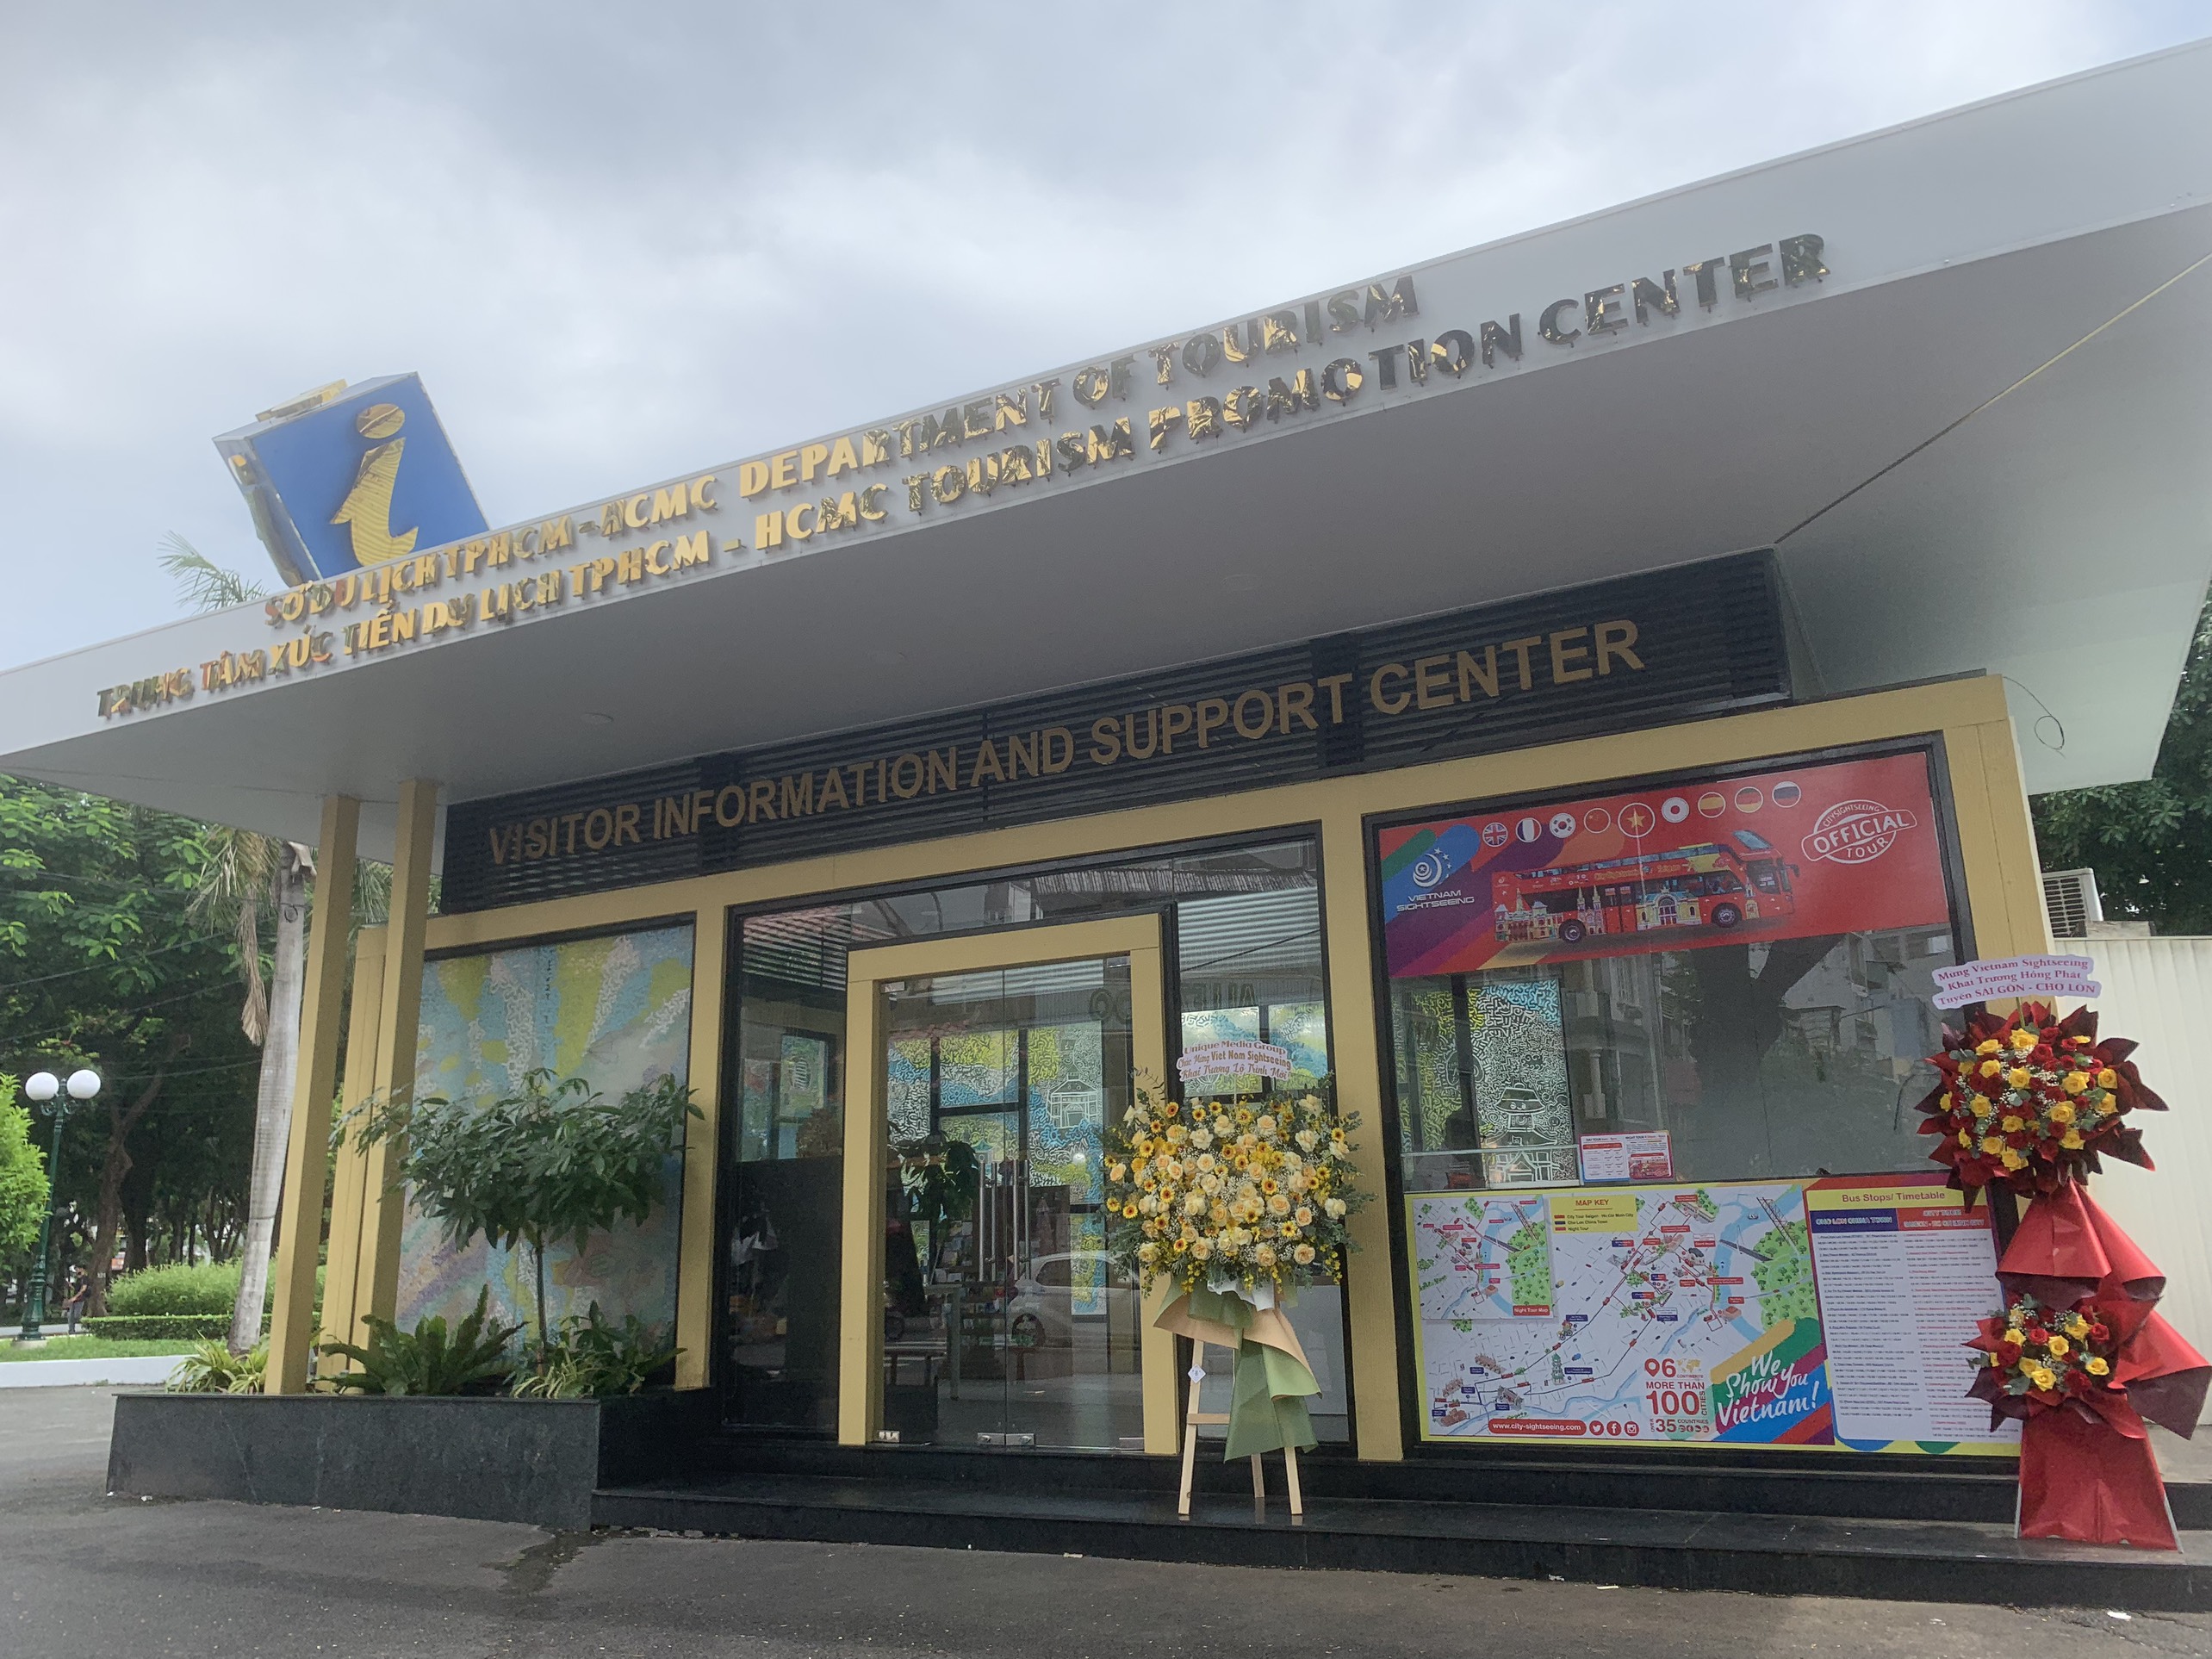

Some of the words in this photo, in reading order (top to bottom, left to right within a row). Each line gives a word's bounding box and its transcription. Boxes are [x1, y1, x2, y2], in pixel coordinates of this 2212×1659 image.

[310, 575, 357, 614] DU
[444, 514, 575, 579] TPHCM
[600, 475, 718, 537] HCMC
[739, 377, 1061, 500] DEPARTMENT
[1072, 354, 1134, 408] OF
[1147, 275, 1420, 388] TOURISM
[97, 668, 195, 718] TRUNG
[200, 649, 265, 693] TÂM
[267, 624, 333, 675] XÚC
[423, 593, 475, 636] DU
[569, 530, 711, 599] TPHCM
[724, 538, 746, 553] -
[755, 482, 891, 553] HCMC
[902, 417, 1134, 513] TOURISM
[1148, 314, 1523, 453] PROMOTION
[1538, 233, 1831, 346] CENTER
[489, 804, 642, 865] VISITOR
[653, 745, 959, 840] INFORMATION
[971, 725, 1075, 787] AND
[1089, 673, 1354, 766] SUPPORT
[1370, 618, 1645, 716] CENTER
[1813, 813, 1910, 854] OFFICIAL
[1847, 836, 1888, 858] TOUR
[1396, 897, 1475, 911] SIGHTSEEING
[1407, 890, 1461, 902] VIETNAM
[1972, 960, 2018, 972] Vietnam
[2022, 958, 2088, 971] Sightseeing
[1948, 979, 1974, 991] Khai
[1184, 1042, 1220, 1054] Unique
[1221, 1040, 1252, 1048] Media
[1253, 1041, 1286, 1055] Group
[1228, 1050, 1246, 1059] Nam
[1247, 1050, 1291, 1071] Sightseeing
[1181, 1066, 1201, 1080] Khai
[1842, 1193, 1861, 1202] Bus
[1863, 1192, 1893, 1203] Stops/
[1897, 1191, 1945, 1201] Timetable
[1662, 1358, 1676, 1377] 6
[1751, 1349, 1780, 1376] We
[1725, 1372, 1776, 1398] Show
[1646, 1390, 1699, 1416] 100
[1718, 1380, 1820, 1426] Vietnam!
[1492, 1422, 1581, 1432] www.city-sightseeing.com
[1656, 1418, 1677, 1432] 35
